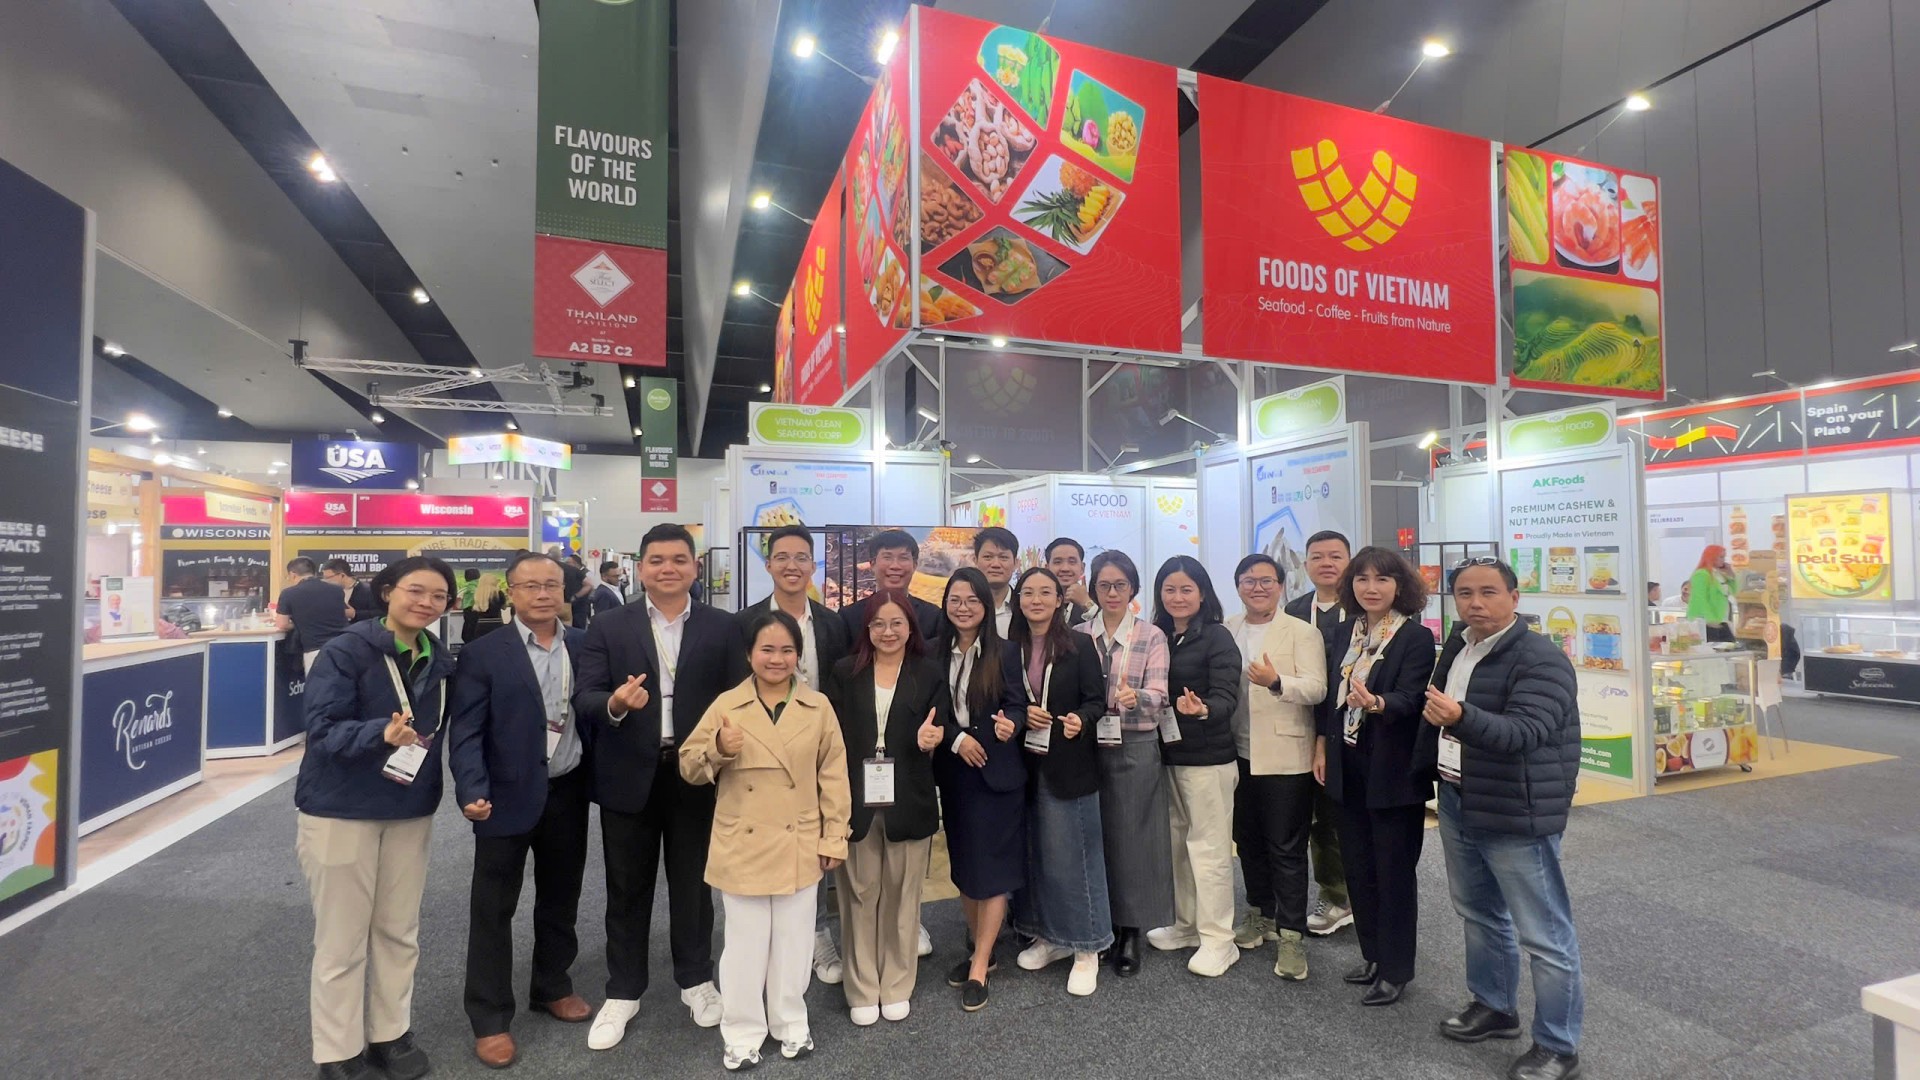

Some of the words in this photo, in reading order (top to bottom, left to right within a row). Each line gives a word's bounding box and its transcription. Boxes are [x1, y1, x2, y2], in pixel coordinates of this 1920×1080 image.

[555, 125, 652, 159] FLAVOURS
[571, 153, 596, 174] OF
[601, 158, 637, 182] THE
[568, 178, 637, 206] WORLD
[1259, 256, 1327, 294] FOODS
[1334, 268, 1360, 298] OF
[1365, 272, 1450, 310] VIETNAM
[566, 308, 638, 324] THAILAND
[1258, 296, 1306, 316] Seafood
[1316, 304, 1351, 320] Coffee
[1361, 309, 1389, 326] Fruits
[1391, 312, 1415, 328] from
[1417, 316, 1451, 333] Nature
[577, 320, 627, 328] PAVILION
[569, 342, 589, 352] A2
[592, 344, 611, 354] B2
[614, 346, 633, 356] C2
[1807, 404, 1848, 418] Spain
[1826, 414, 1845, 424] on
[1848, 410, 1884, 423] your
[775, 417, 814, 428] VIETNAM
[815, 419, 843, 429] CLEAN
[776, 430, 816, 438] SEAFOOD
[818, 430, 843, 440] CORP
[1814, 426, 1851, 437] Plate
[326, 446, 387, 468] USA
[1532, 474, 1586, 488] AKFoods
[325, 502, 346, 511] USA
[1071, 494, 1128, 507] SEAFOOD
[1510, 504, 1556, 514] PREMIUM
[1558, 500, 1605, 511] CASHEW
[1608, 498, 1615, 508] &
[420, 504, 474, 515] Wisconsin
[504, 505, 523, 514] USA
[1088, 510, 1099, 518] OF
[1100, 510, 1132, 519] VIETNAM
[1509, 517, 1528, 526] NUT
[1530, 512, 1618, 526] MANUFACTURER
[36, 524, 46, 537] &
[186, 528, 272, 538] WISCONSIN
[1525, 532, 1551, 540] Proudly
[1581, 530, 1614, 538] Vietnam
[452, 538, 489, 550] TRADE
[1796, 548, 1838, 564] Deli
[1840, 554, 1884, 564] Sun
[112, 690, 174, 770] Renards
